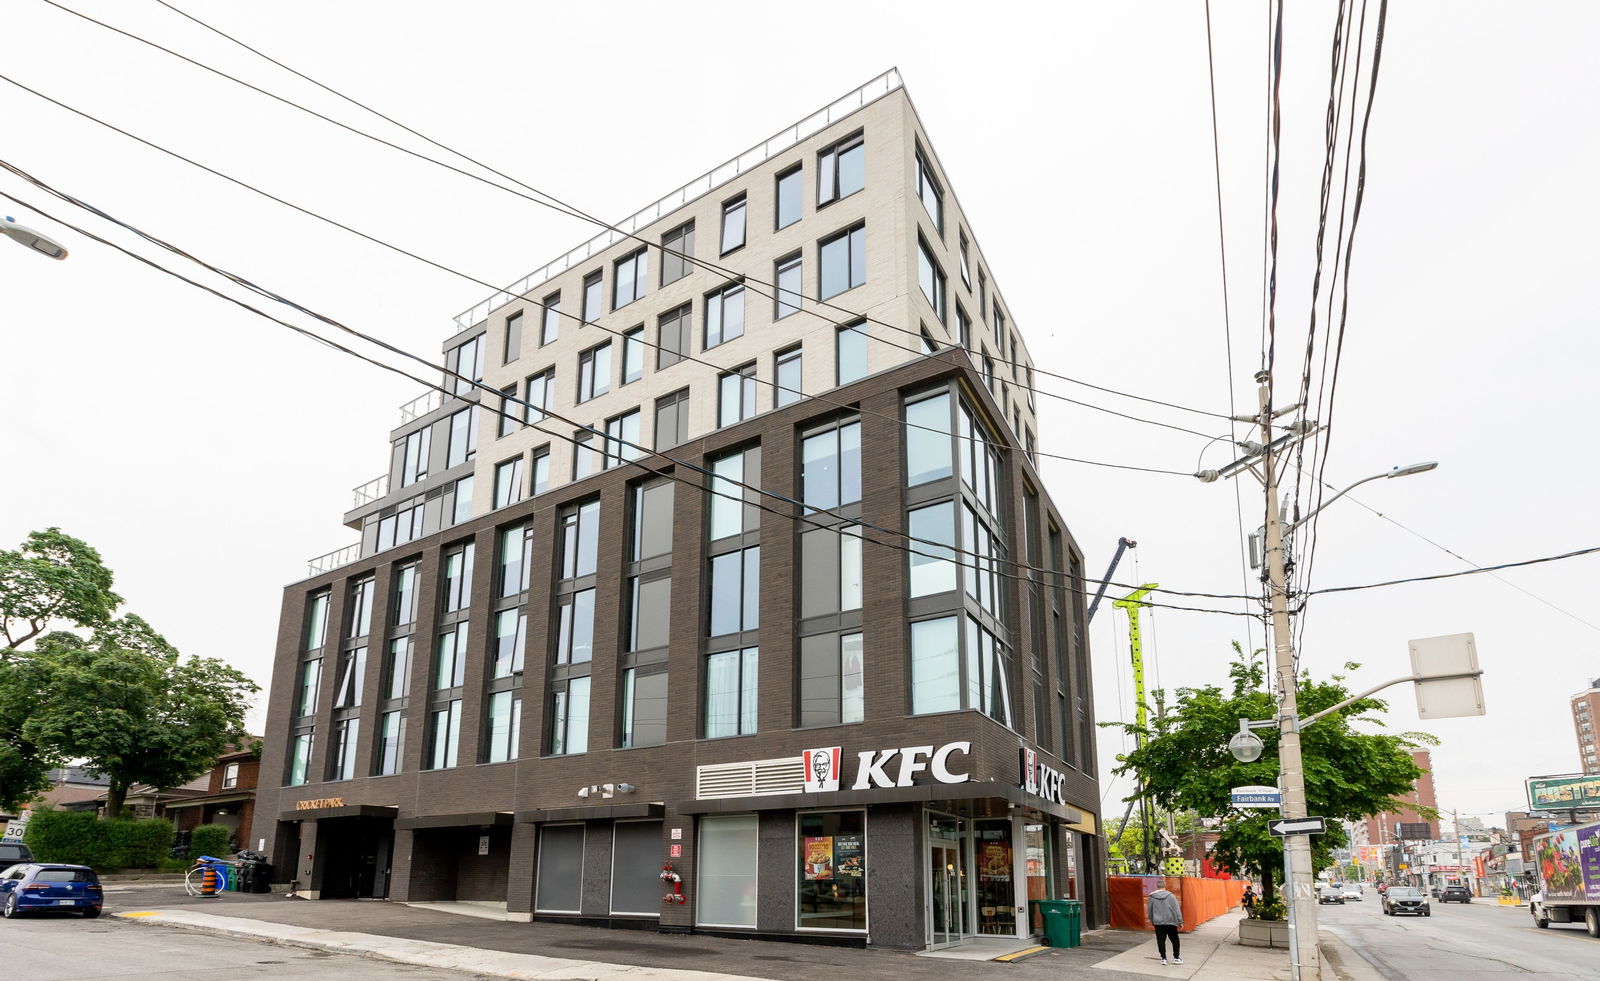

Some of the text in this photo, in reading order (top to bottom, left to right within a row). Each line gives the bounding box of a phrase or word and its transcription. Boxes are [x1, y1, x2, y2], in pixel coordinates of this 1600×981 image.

[852, 741, 971, 790] KFC
[1040, 763, 1066, 806] KFC
[296, 797, 345, 811] CRICKET PARK
[7, 827, 23, 837] 30
